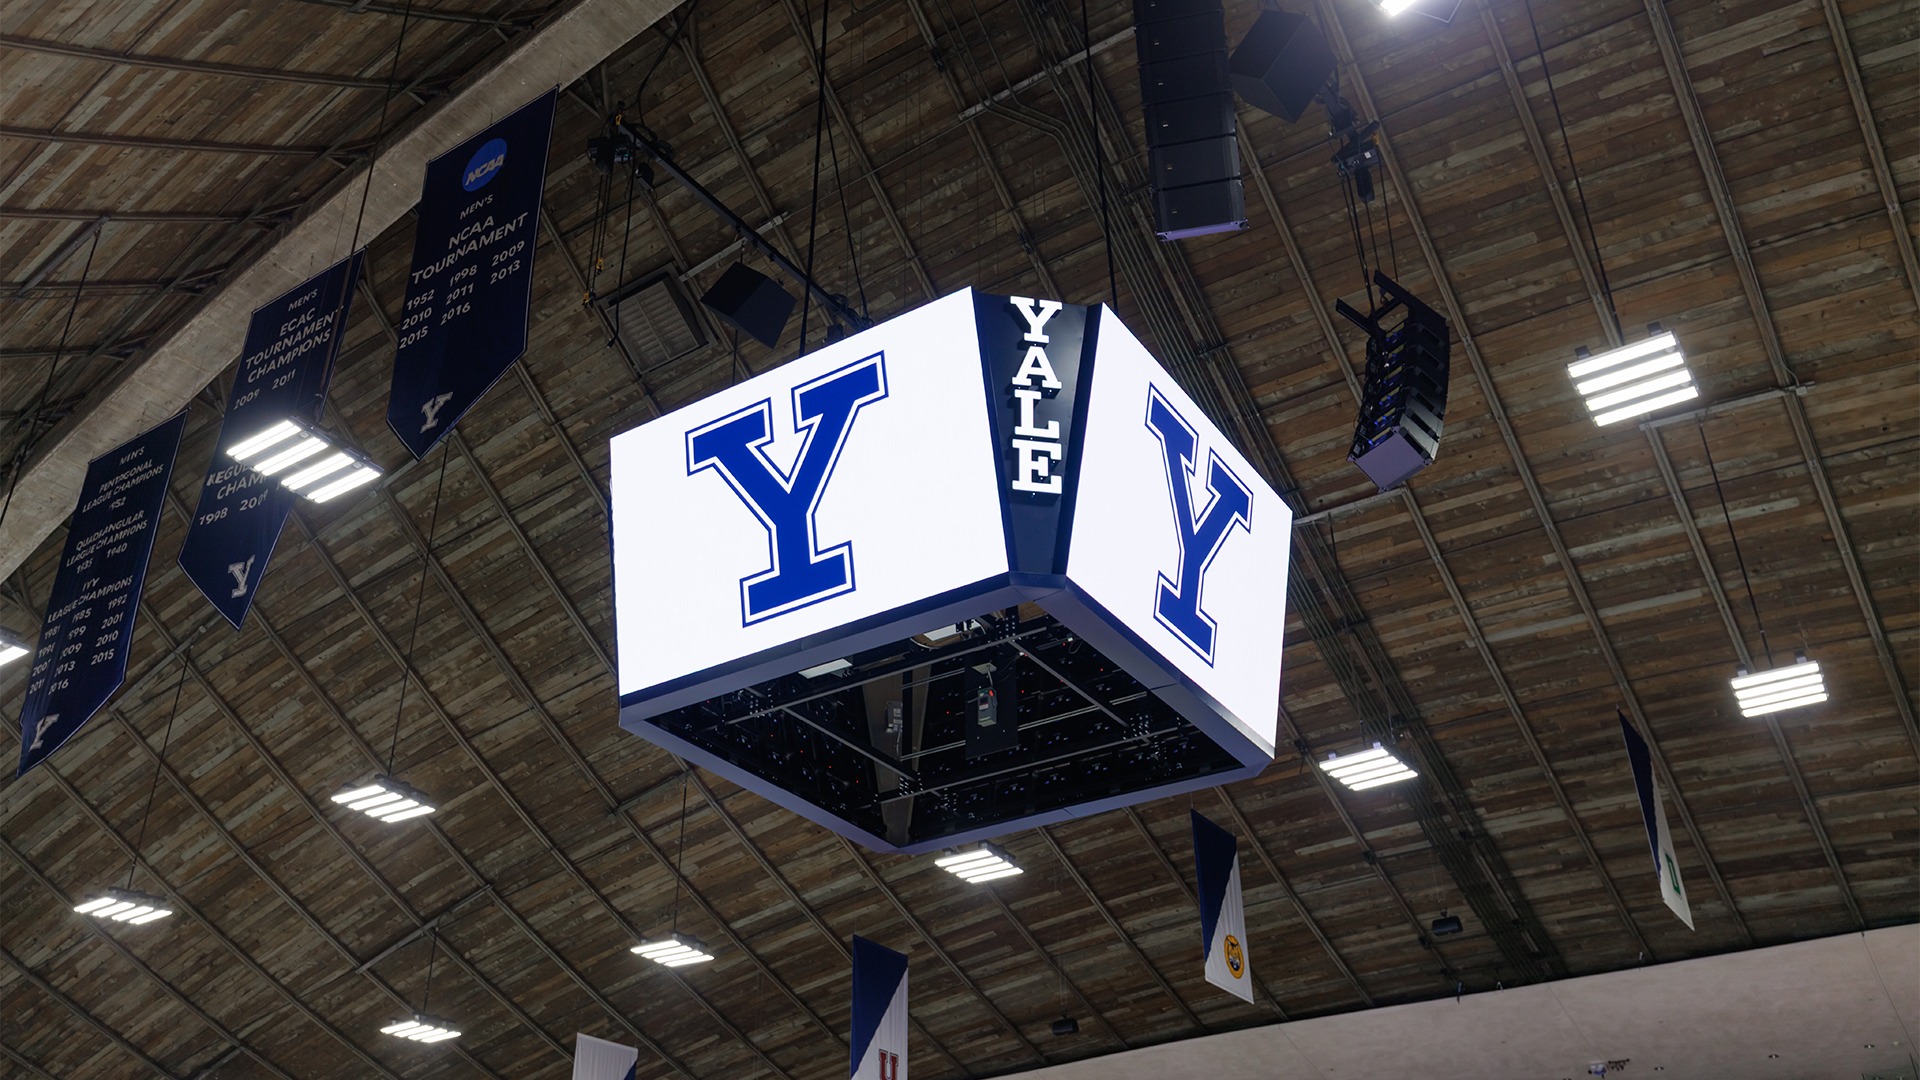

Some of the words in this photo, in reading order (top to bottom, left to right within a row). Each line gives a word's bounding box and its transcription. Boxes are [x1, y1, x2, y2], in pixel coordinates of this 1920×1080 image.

[465, 154, 504, 185] NCAA
[460, 194, 493, 220] MEN'S
[412, 212, 528, 285] TOURNAMENT
[448, 215, 495, 250] NCAA
[401, 307, 432, 330] 2010
[445, 282, 474, 305] 2011
[489, 259, 521, 285] 2013
[406, 289, 435, 311] 1952
[449, 264, 478, 287] 1998
[491, 240, 525, 267] 2009
[288, 288, 318, 312] MEN'S
[280, 307, 316, 337] ECAC
[399, 326, 428, 350] 2015
[440, 302, 471, 326] 2016
[248, 328, 331, 383] CHAMPIONS
[233, 388, 260, 411] 2009
[271, 368, 296, 390] 2011
[1009, 295, 1063, 494] YALE
[420, 391, 453, 434] Y
[82, 490, 112, 513] LEAGUE
[113, 463, 164, 496] CHAMPIONS
[99, 459, 153, 494] PENTAGONAL
[216, 472, 267, 500] CHAM
[685, 350, 889, 628] Y
[109, 496, 127, 511] 952
[199, 507, 228, 526] 1998
[66, 543, 96, 568] LEAGUE
[95, 519, 148, 550] CHAMPIONS
[1144, 382, 1254, 668] Y
[82, 577, 100, 592] IVY
[227, 554, 255, 599] Y
[47, 599, 78, 624] LEAGUE
[78, 575, 133, 606] CHAMPIONS
[107, 594, 128, 611] 1992
[67, 625, 87, 640] 999
[101, 612, 124, 630] 2001
[95, 630, 119, 648] 2010
[90, 648, 115, 666] 2015
